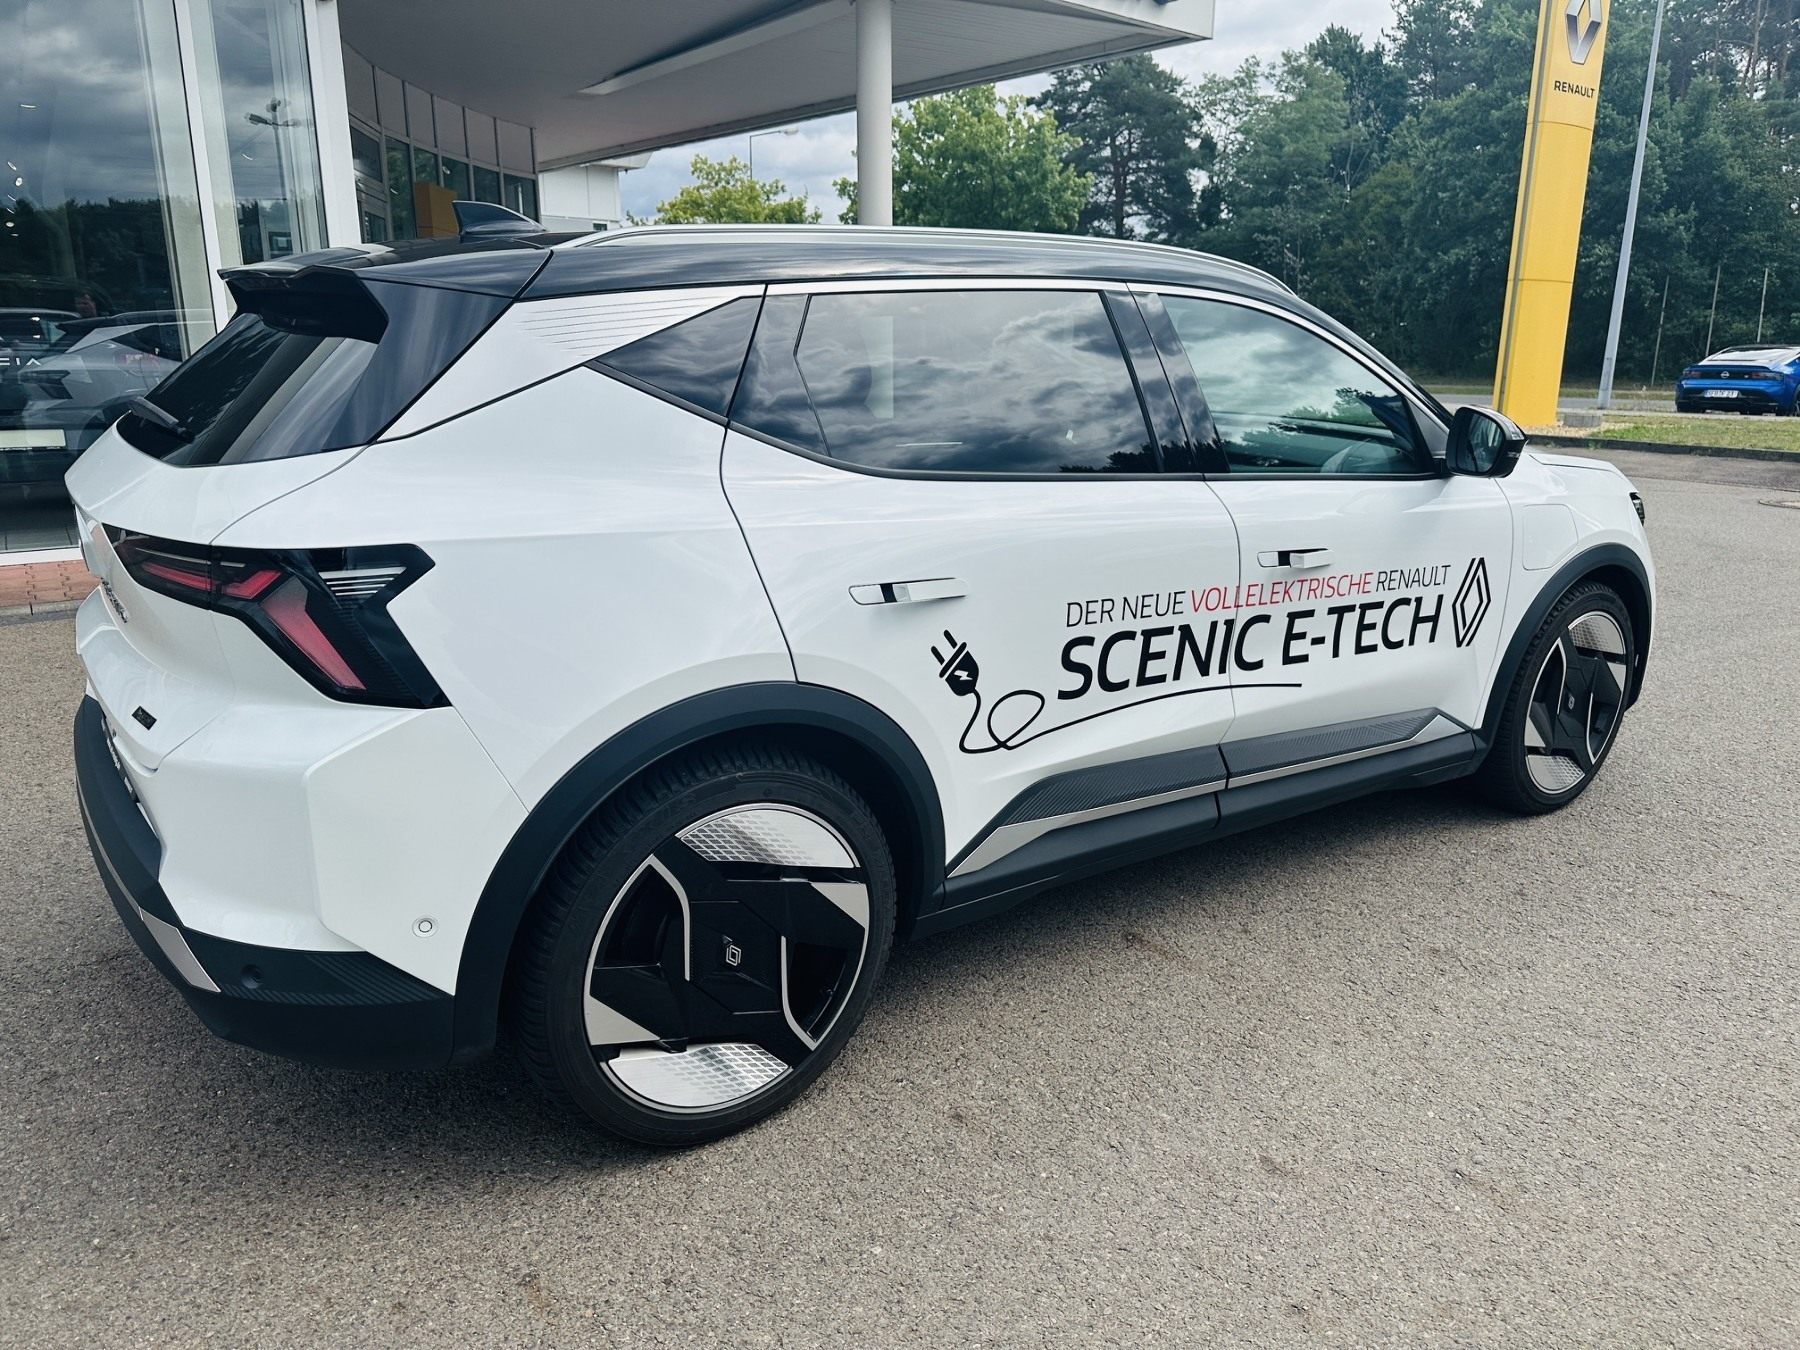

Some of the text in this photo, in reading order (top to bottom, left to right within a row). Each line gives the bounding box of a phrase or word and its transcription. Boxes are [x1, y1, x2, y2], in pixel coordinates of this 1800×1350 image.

[1553, 80, 1595, 99] RENAULT
[1066, 564, 1451, 627] DER NEUE VOLLELEKTRISCHE RENAULT
[1057, 593, 1444, 700] SCENIC E-TECH
